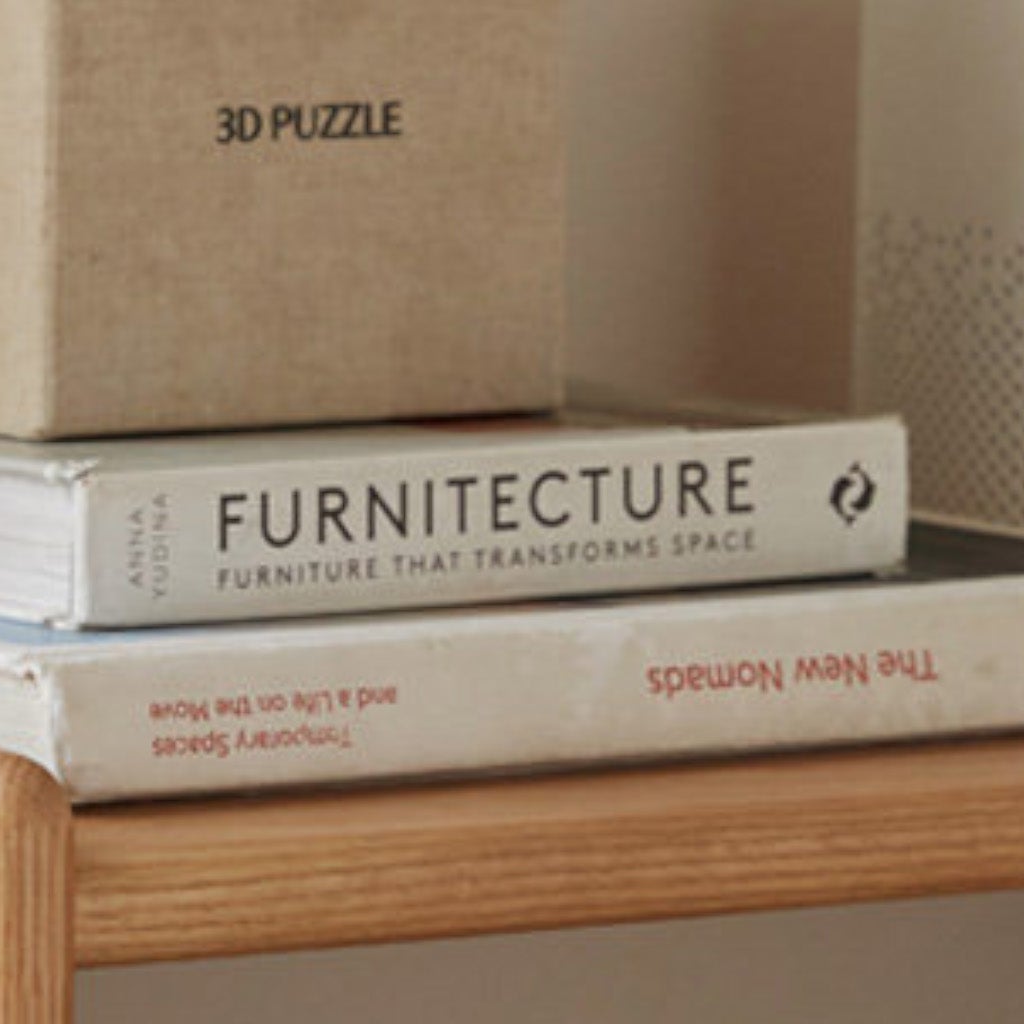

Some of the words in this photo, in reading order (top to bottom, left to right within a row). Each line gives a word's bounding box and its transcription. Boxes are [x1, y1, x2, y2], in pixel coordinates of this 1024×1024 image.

[216, 106, 262, 145] 3D
[270, 101, 403, 143] PUZZLE
[219, 456, 756, 553] FURNITECTURE
[128, 508, 145, 587] ANNA
[151, 493, 170, 599] YUDINA
[216, 556, 379, 591] FURNITURE
[392, 550, 462, 574] THAT
[475, 535, 660, 570] TRANSFORMS
[672, 529, 756, 556] SPACE
[644, 659, 784, 699] Nomads
[796, 653, 870, 686] New
[877, 649, 938, 682] The
[215, 695, 252, 716] the
[257, 693, 288, 712] on
[292, 689, 333, 714] Life
[338, 688, 352, 708] a
[357, 686, 397, 711] and
[151, 731, 231, 758] Spaces
